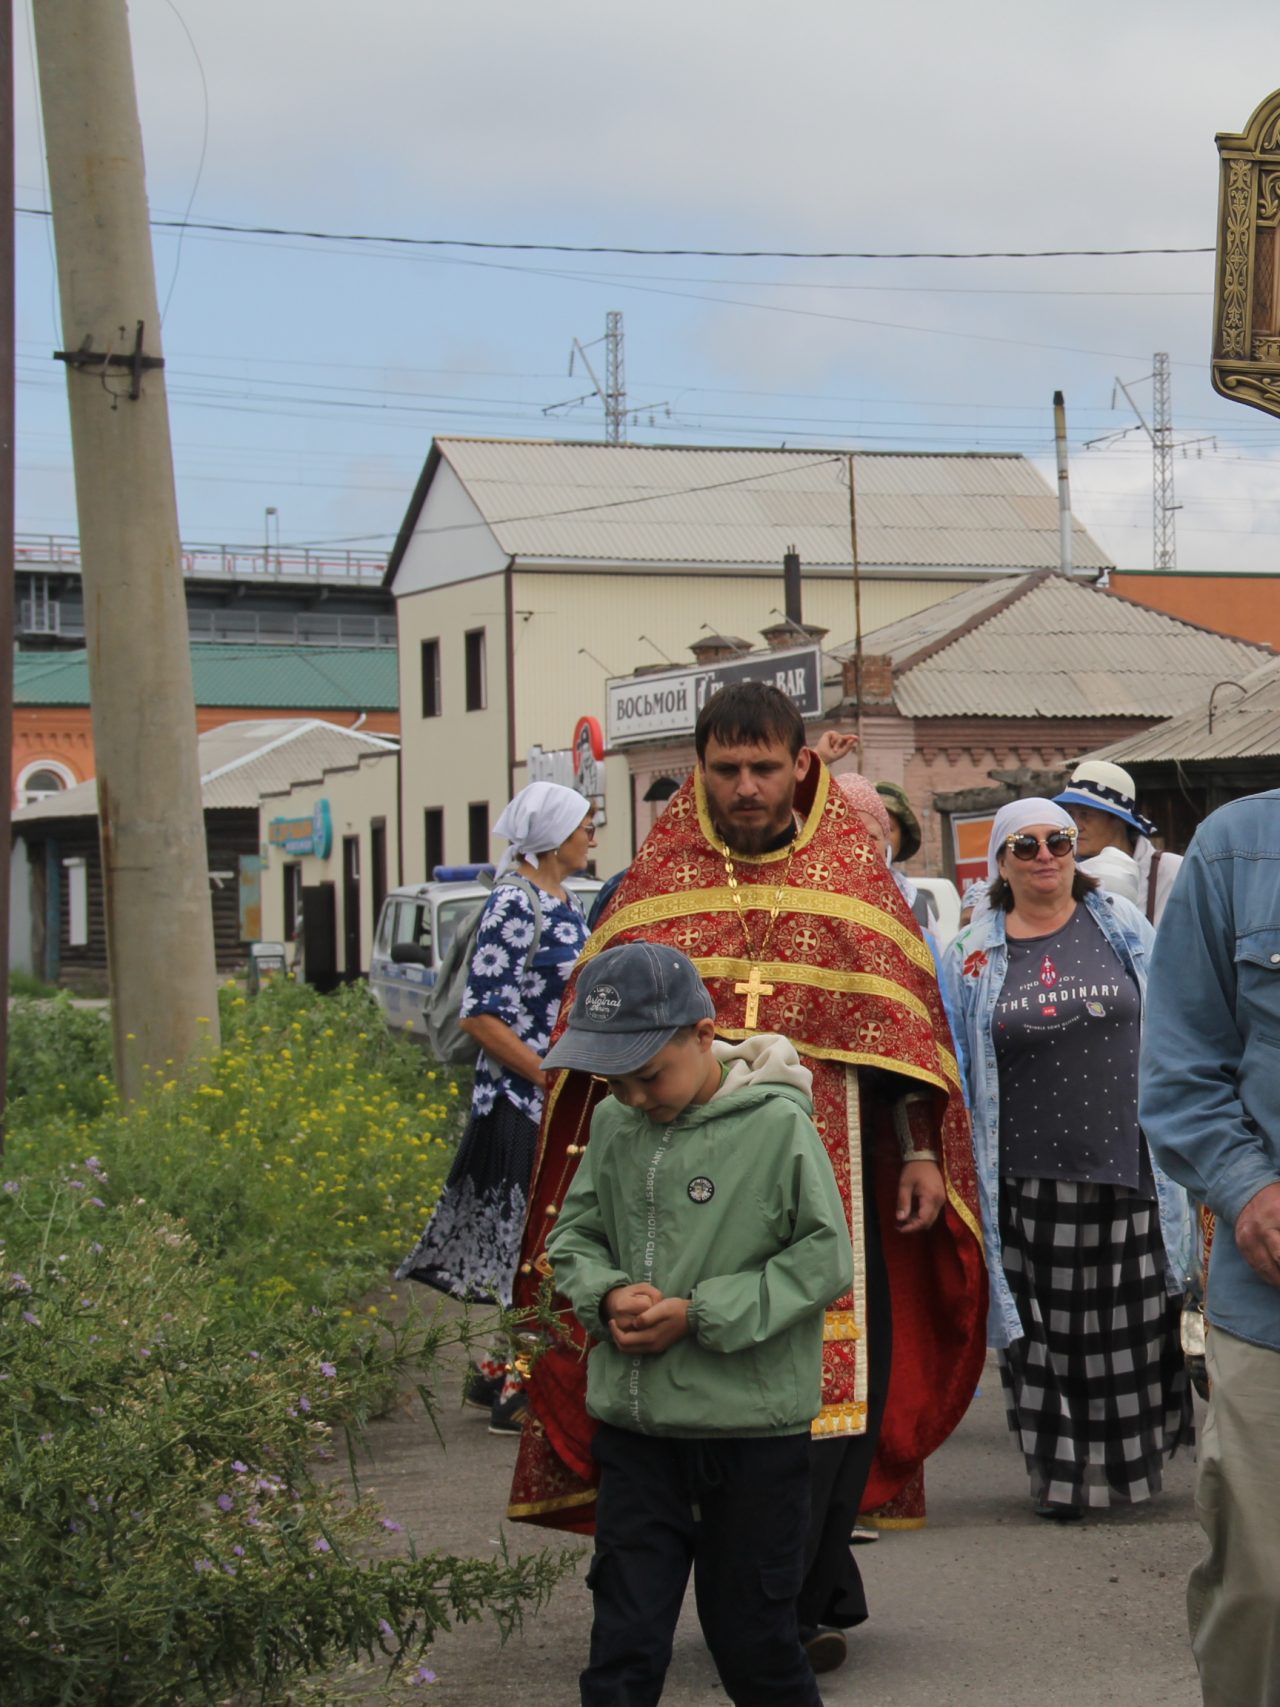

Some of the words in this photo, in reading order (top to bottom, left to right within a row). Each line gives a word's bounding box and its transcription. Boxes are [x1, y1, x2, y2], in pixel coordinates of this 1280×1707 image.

[616, 681, 688, 721] ВОСЬМОЙ
[1019, 981, 1039, 991] FIND
[1058, 975, 1076, 983] JOY
[1001, 996, 1029, 1014] THE
[1038, 984, 1120, 1004] ORDINARY
[644, 1240, 656, 1267] CLUB
